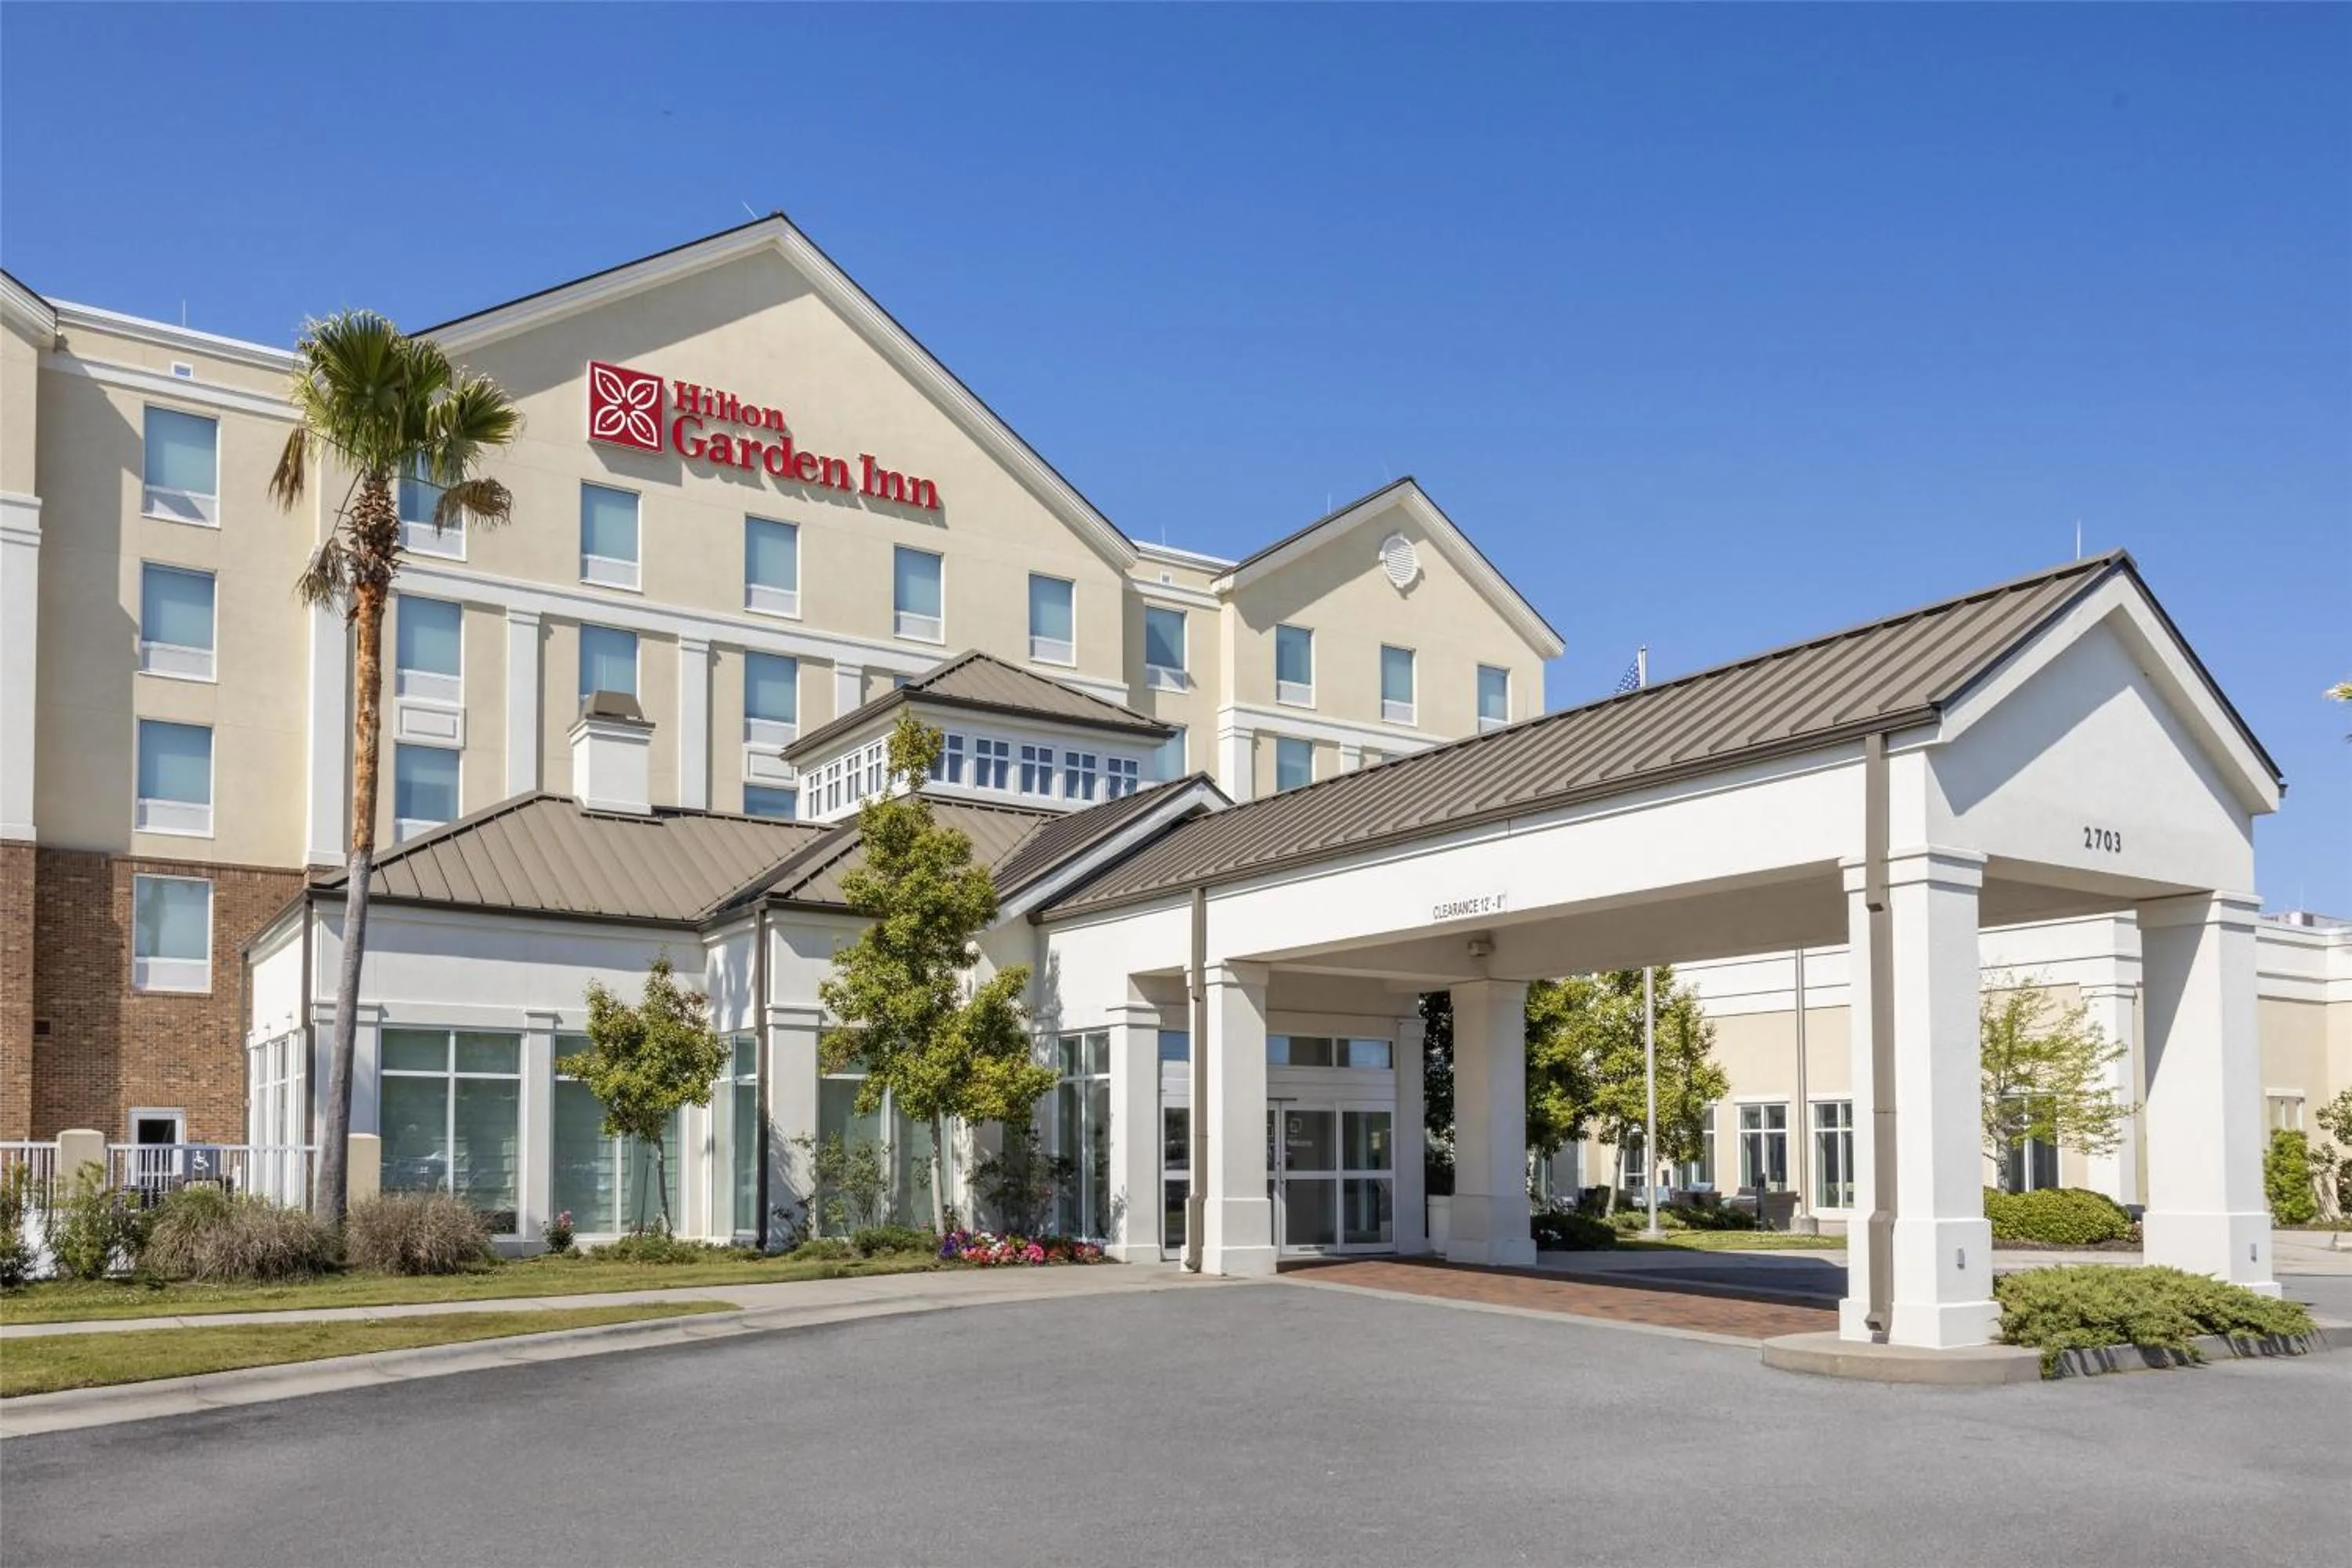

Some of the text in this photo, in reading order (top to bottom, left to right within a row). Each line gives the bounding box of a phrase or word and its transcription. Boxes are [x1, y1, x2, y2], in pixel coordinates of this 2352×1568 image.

[673, 381, 785, 433] Hilton
[672, 415, 940, 510] Garden Inn
[2084, 826, 2121, 854] 2703
[1432, 899, 1479, 920] CLEARANCE
